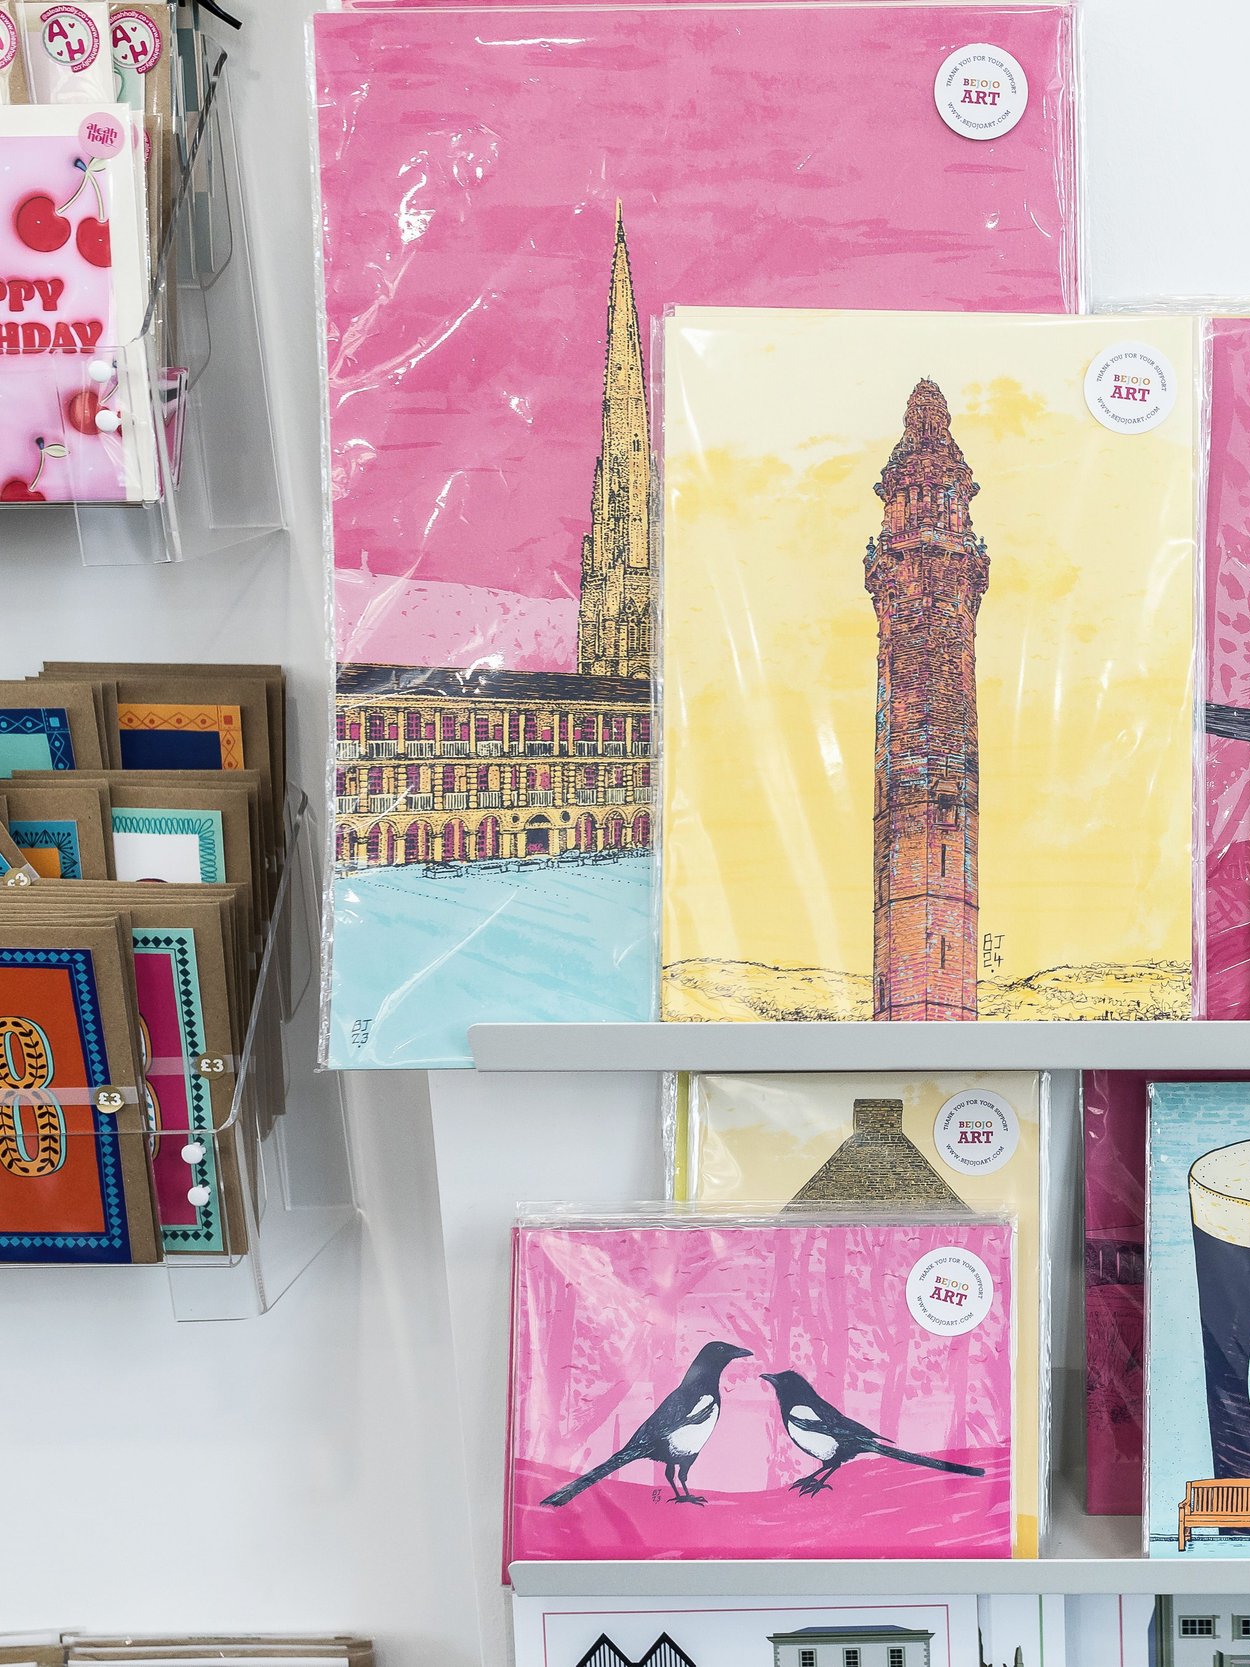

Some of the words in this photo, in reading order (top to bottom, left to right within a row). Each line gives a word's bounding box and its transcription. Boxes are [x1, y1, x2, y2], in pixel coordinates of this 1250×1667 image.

[946, 66, 960, 87] THANK
[958, 57, 972, 67] YOU
[988, 57, 1004, 69] YOUR
[1003, 67, 1017, 94] SUPPORT
[963, 78, 1000, 90] BEJOJO
[960, 89, 1000, 106] ART
[948, 101, 1011, 129] WWW.BEJOJOART.COM
[1096, 362, 1111, 382] THANK
[1110, 354, 1123, 364] YOU
[1139, 354, 1155, 366] YOUR
[1154, 365, 1167, 392] SUPPORT
[1113, 374, 1151, 386] BEJOJO
[1110, 385, 1150, 402] ART
[1097, 396, 1160, 424] WWW.BEJOJOART.COM
[200, 1059, 224, 1072] £3
[98, 1092, 122, 1106] £3
[943, 1111, 955, 1130] THANK
[953, 1102, 965, 1112] YOU
[979, 1100, 995, 1110] YOUR
[994, 1107, 1009, 1132] SUPPORT
[958, 1121, 993, 1130] BEJOJO
[957, 1131, 994, 1144] ART
[946, 1143, 1005, 1167] WWW.BEJOJOART.COM
[919, 1263, 935, 1282] THANK
[934, 1258, 947, 1266] YOU
[962, 1260, 976, 1273] YOUR
[973, 1272, 984, 1300] SUPPORT
[935, 1276, 969, 1291] BEJOJO
[929, 1286, 968, 1307] ART
